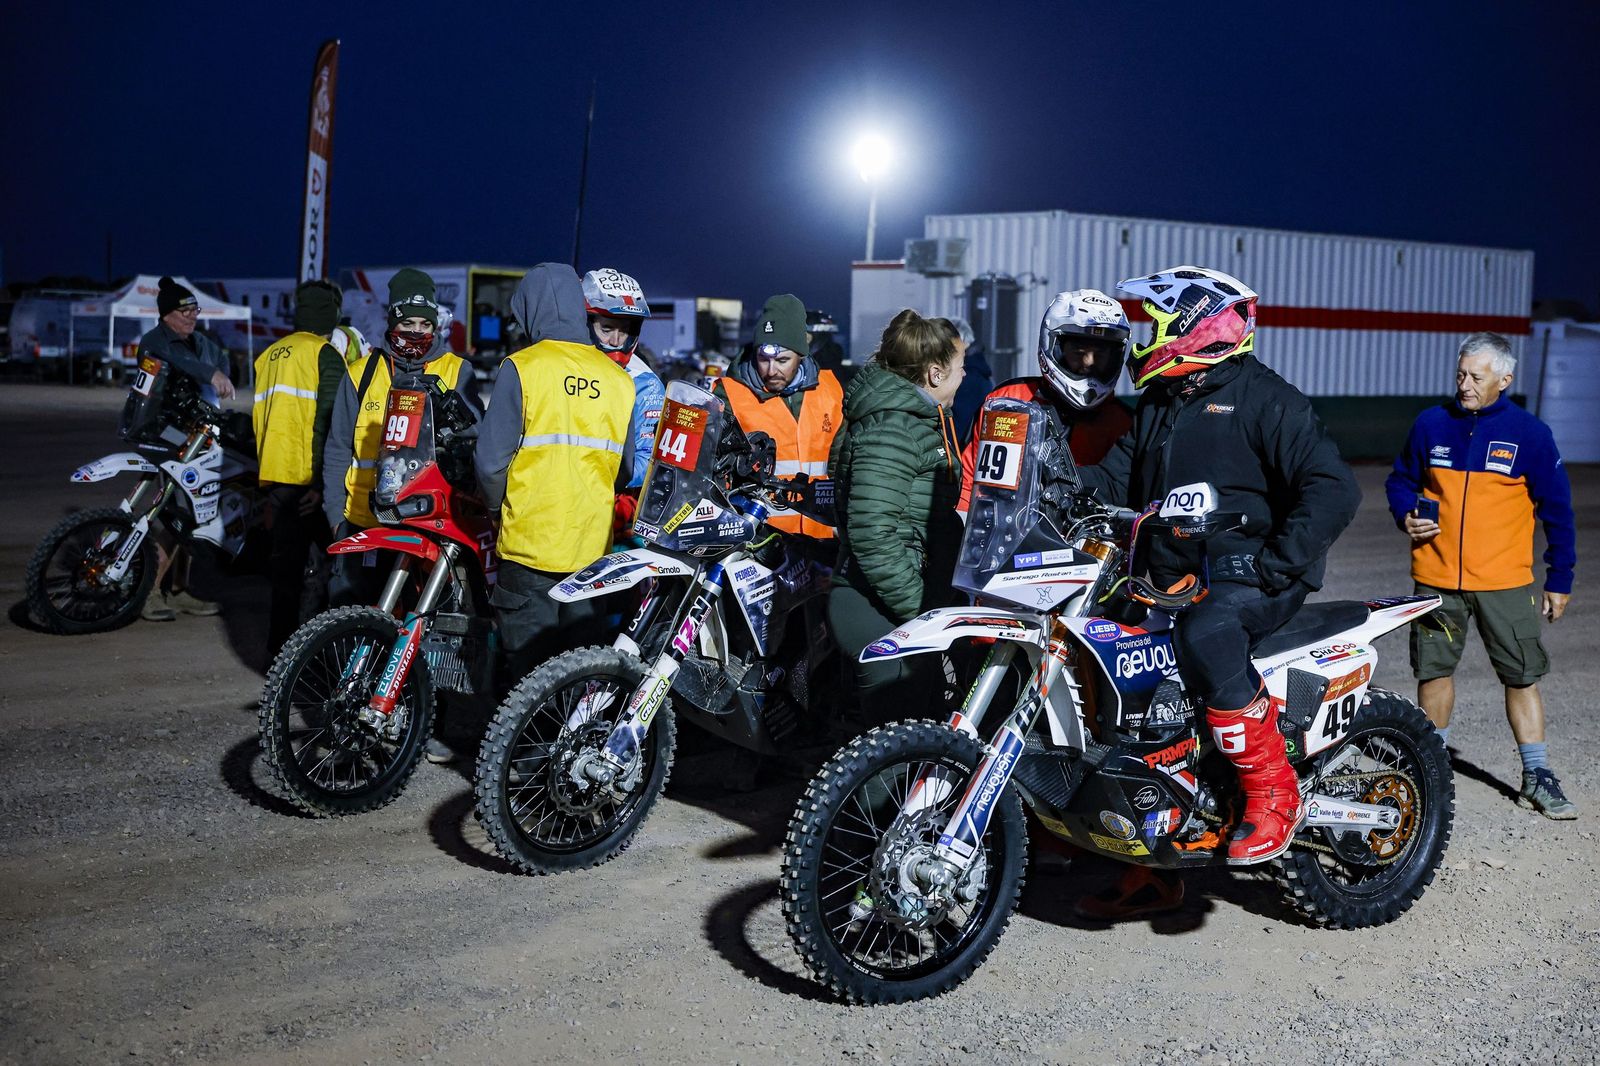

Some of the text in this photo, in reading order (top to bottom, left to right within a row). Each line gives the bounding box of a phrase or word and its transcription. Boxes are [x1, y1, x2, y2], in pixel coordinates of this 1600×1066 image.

[1085, 297, 1110, 305] Arai
[1179, 295, 1210, 332] LS2
[269, 345, 292, 362] GPS
[564, 375, 601, 400] GPS
[365, 401, 380, 412] GPS
[678, 407, 700, 420] DREAM.
[385, 414, 409, 442] 99
[995, 416, 1019, 425] DREAM.
[658, 427, 688, 463] 44
[978, 443, 1008, 481] 49
[1490, 448, 1513, 460] KTM
[717, 521, 745, 531] RALLY
[719, 528, 745, 537] BIKES
[1018, 555, 1039, 565] YPF
[1230, 555, 1245, 576] FOX
[1003, 573, 1039, 582] Santiago
[1089, 623, 1117, 634] LIESS
[1116, 636, 1152, 651] Provincia del
[385, 647, 403, 680] KOVE
[393, 642, 415, 691] DUNLOP
[1322, 693, 1356, 741] 49
[1212, 722, 1246, 754] G
